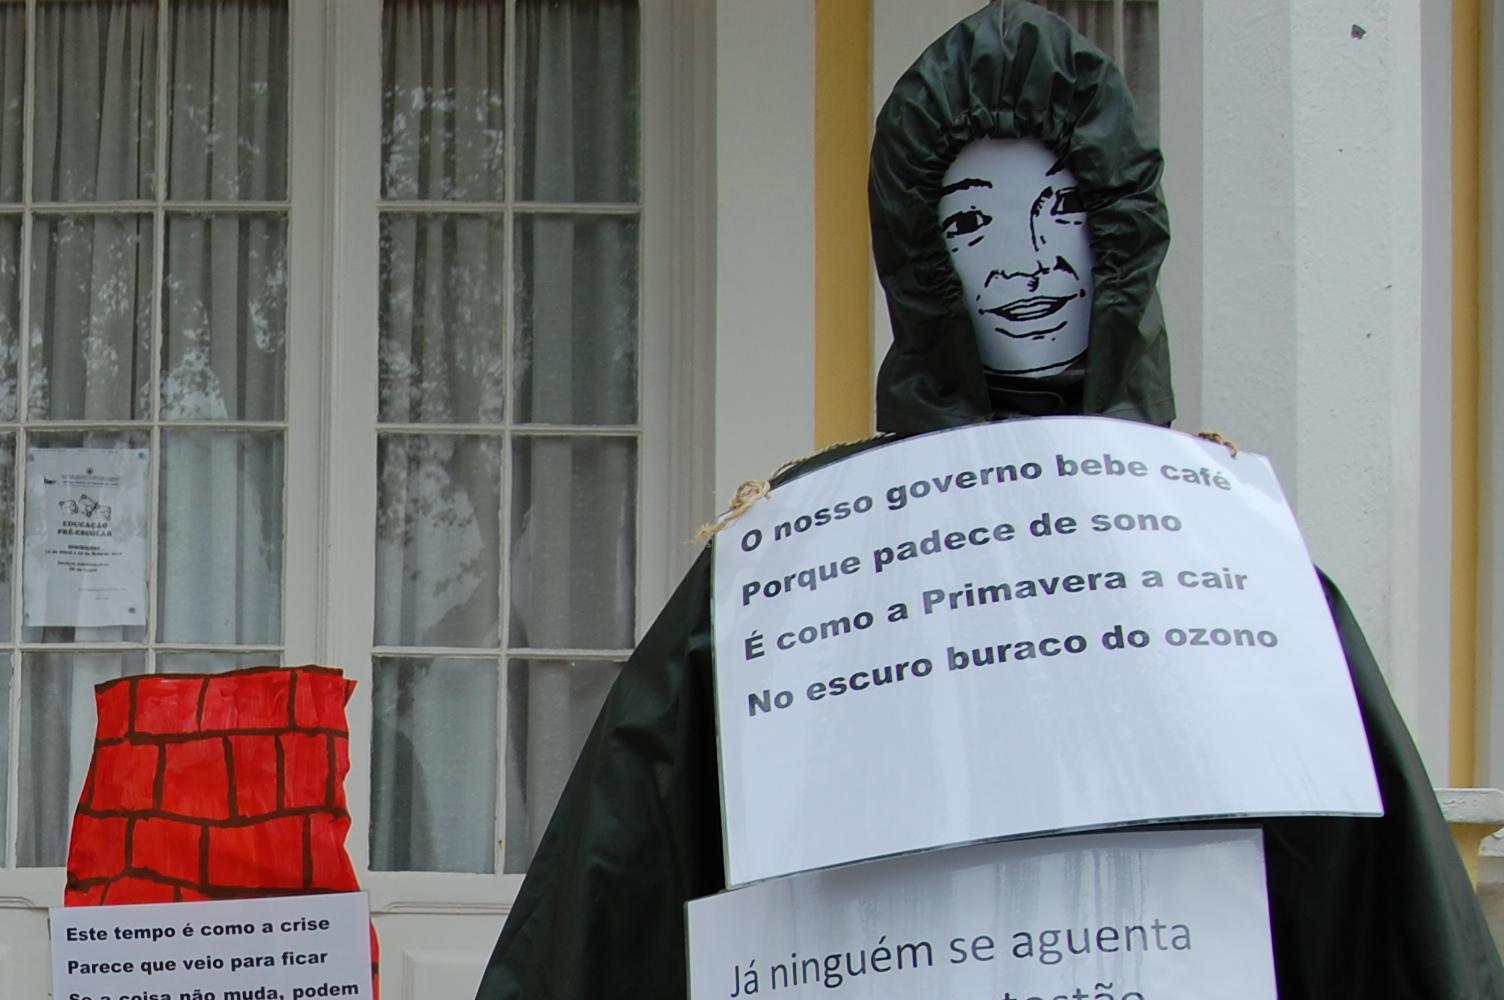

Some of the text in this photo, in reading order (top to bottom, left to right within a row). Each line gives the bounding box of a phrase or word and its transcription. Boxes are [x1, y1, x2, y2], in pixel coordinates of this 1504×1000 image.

[740, 453, 1231, 553] O nosso governo bebe café
[742, 511, 1182, 607] Porque padece de sono
[744, 567, 1248, 661] É como a Primavera a cair
[747, 624, 1278, 717] No escuro buraco do ozono
[66, 916, 330, 943] Este tempo é como a crise
[67, 951, 328, 976] Parece que veio para ficar
[730, 918, 1192, 999] Já ninguém se aguenta
